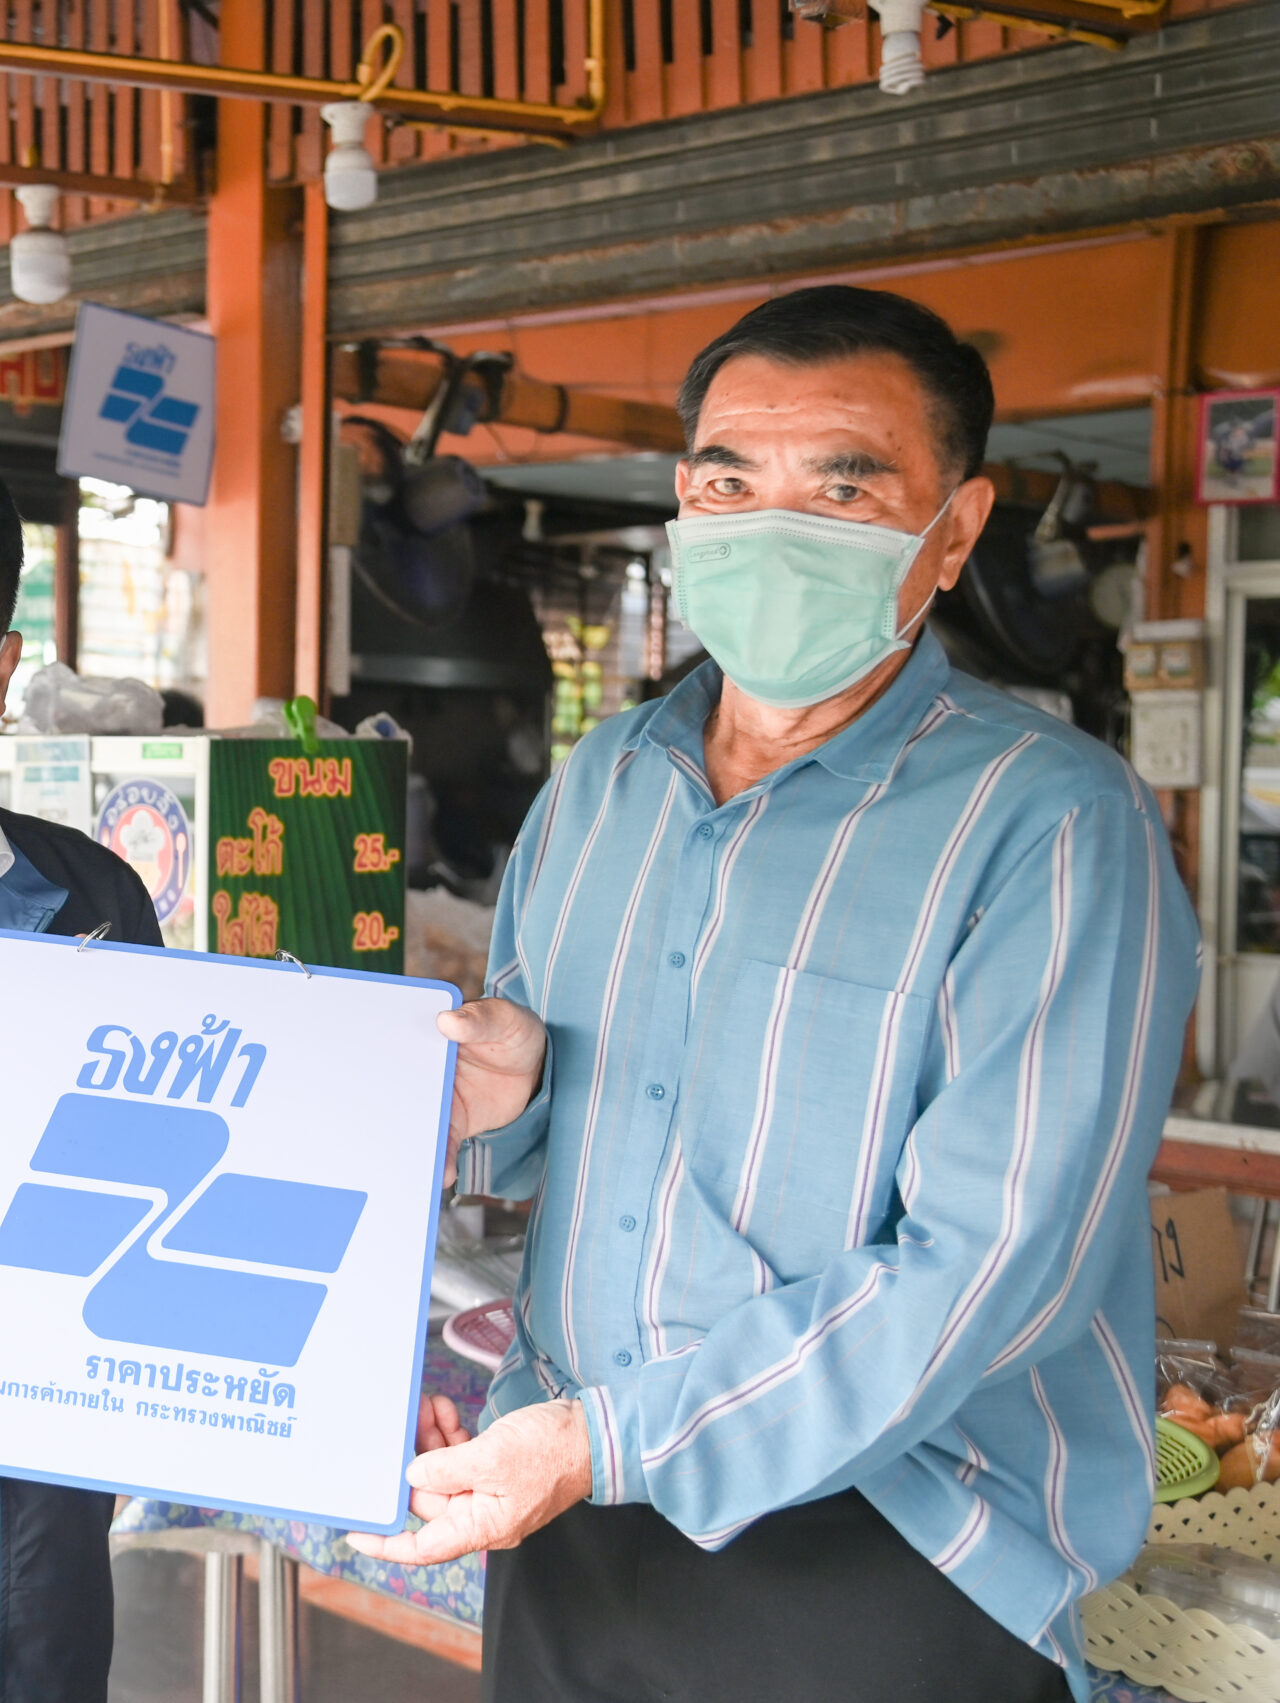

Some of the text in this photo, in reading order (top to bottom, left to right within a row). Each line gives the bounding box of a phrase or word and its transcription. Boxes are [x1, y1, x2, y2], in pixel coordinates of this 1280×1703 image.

[269, 757, 352, 797] ขนม
[216, 806, 401, 877] ตะโก้ 25.-
[76, 1013, 267, 1108] ธงฟ้า
[85, 1353, 297, 1409] ราคาประหยัด
[135, 1396, 298, 1439] กระทรวงพาณิชย์
